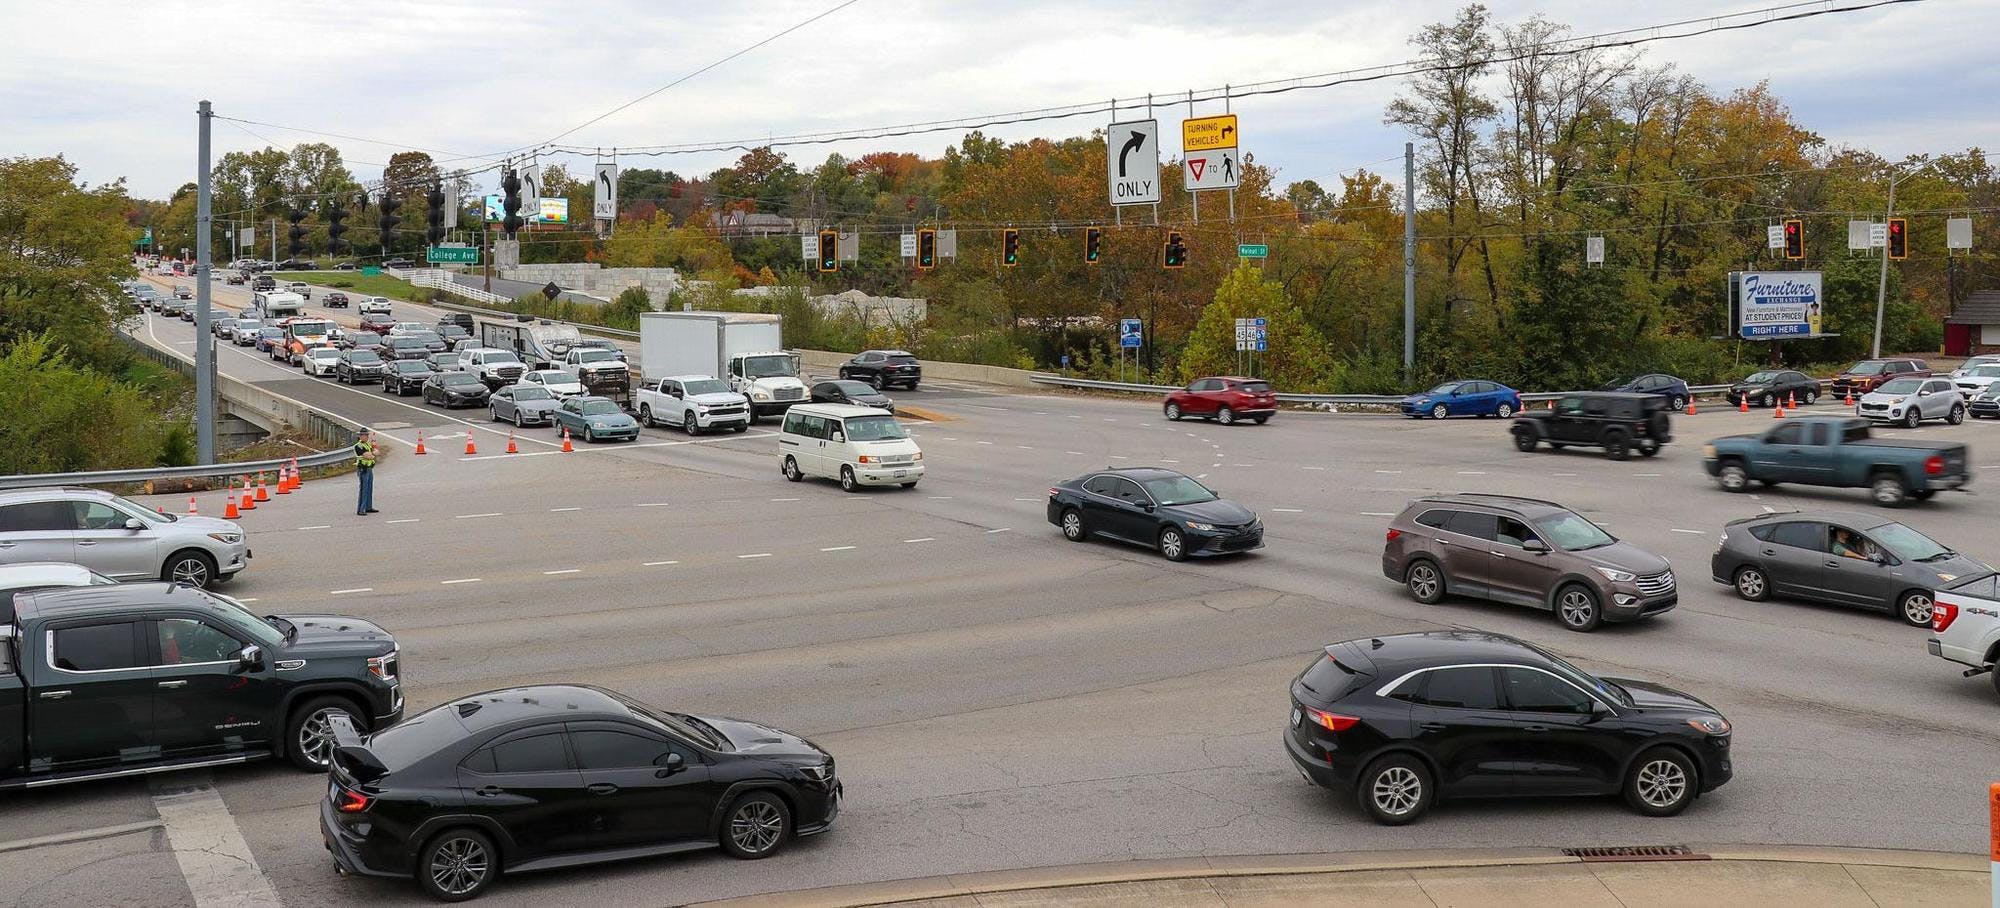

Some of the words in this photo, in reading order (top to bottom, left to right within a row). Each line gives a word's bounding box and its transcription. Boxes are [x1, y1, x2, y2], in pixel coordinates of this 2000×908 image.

[1187, 123, 1218, 134] TURNING
[1187, 136, 1219, 146] VEHICLES
[1208, 165, 1218, 173] TO
[1117, 180, 1151, 198] ONLY
[524, 201, 537, 213] ONLY
[597, 202, 612, 213] ONLY
[430, 251, 457, 260] College
[462, 251, 475, 259] Ave
[1745, 275, 1811, 301] Furniture
[1753, 313, 1780, 321] STUDENT
[1781, 312, 1804, 320] PRICES!
[1256, 329, 1265, 339] 69
[1752, 326, 1777, 334] RIGHT
[1779, 325, 1799, 333] HERE
[1237, 331, 1245, 340] 45
[1247, 331, 1255, 340] 46
